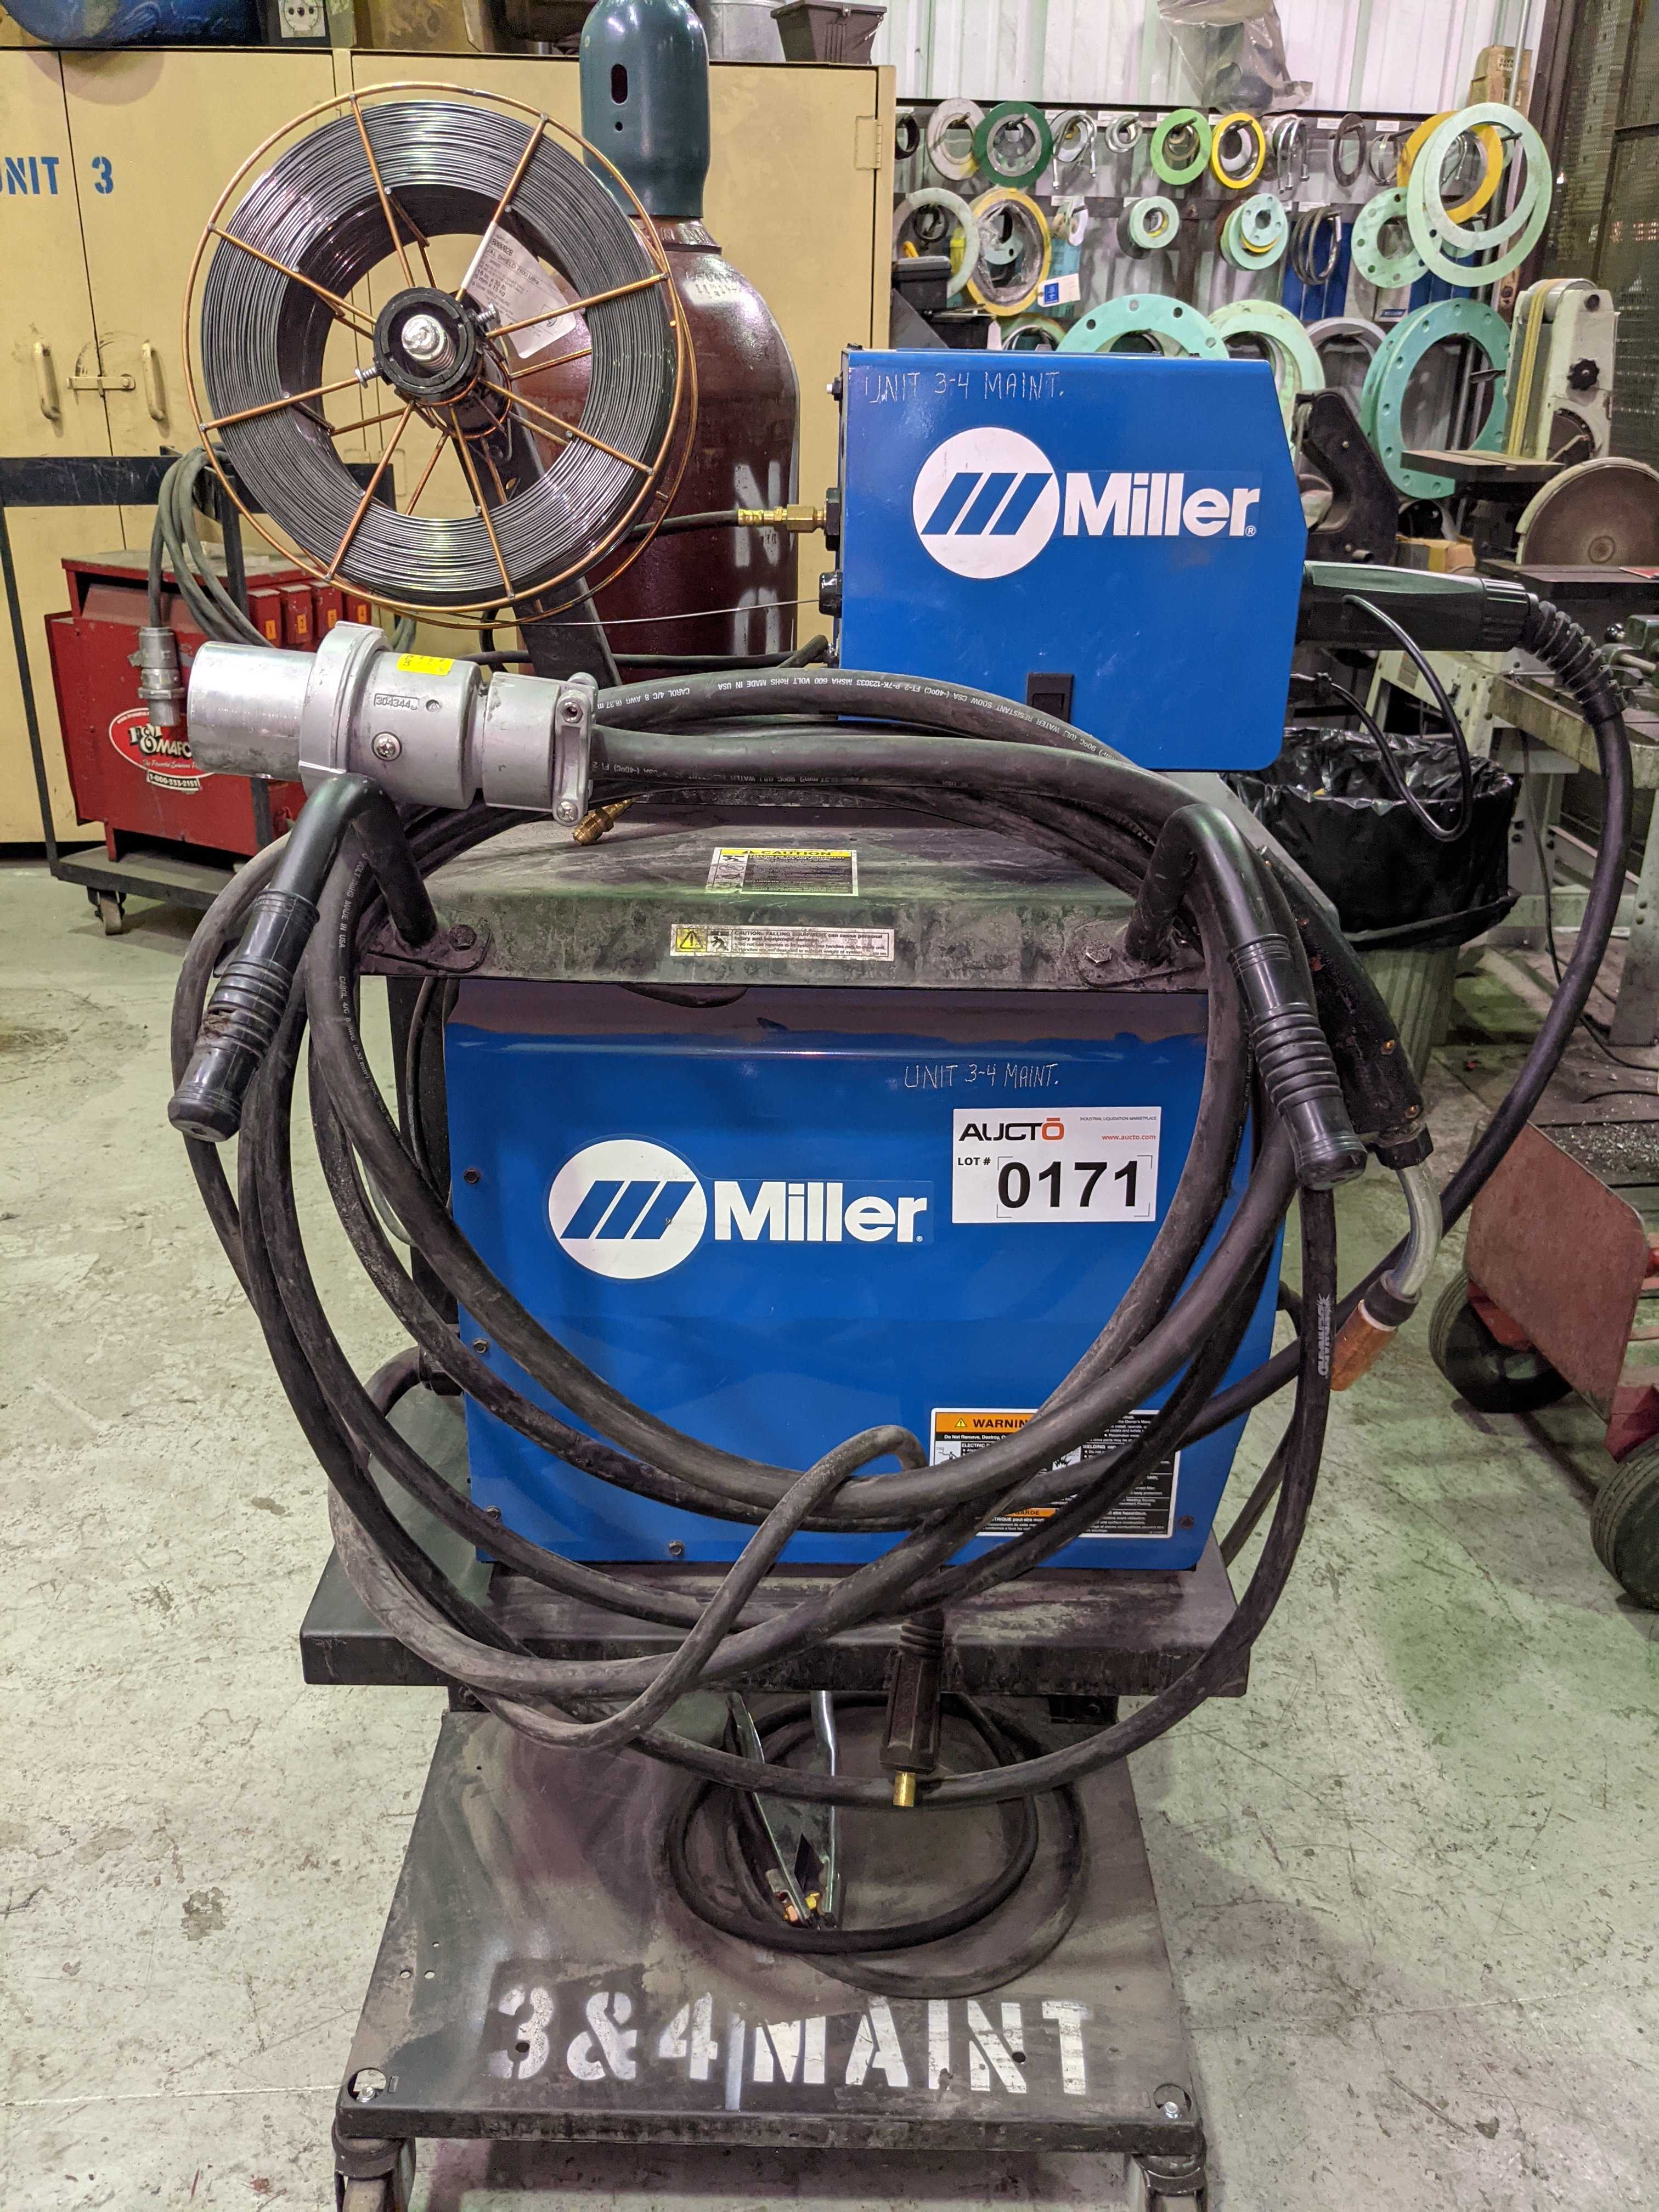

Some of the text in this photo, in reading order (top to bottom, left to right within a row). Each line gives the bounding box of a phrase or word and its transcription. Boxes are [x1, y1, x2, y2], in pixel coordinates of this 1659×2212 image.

[0, 156, 114, 194] NIT 3
[497, 254, 516, 269] SHIELD
[866, 371, 1065, 403] UNIT 3-4 MAINT.
[1063, 472, 1261, 537] Miller
[718, 682, 732, 691] USA
[747, 679, 766, 688] MADE
[625, 696, 641, 704] AWG
[668, 687, 690, 698] CAROL
[953, 692, 968, 702] CSA
[996, 705, 1034, 723] RESISTANT
[1036, 718, 1060, 734] WATER
[341, 900, 352, 921] MADE
[340, 923, 348, 932] IN
[338, 934, 347, 949] USA
[905, 1064, 958, 1089] UNIT
[1005, 1063, 1059, 1089] MAINT.
[957, 1156, 991, 1166] LOT #
[998, 1160, 1138, 1208] 0171
[714, 1181, 928, 1243] Miller
[973, 1419, 1028, 1429] WARNIN
[754, 1994, 1091, 2096] MAINT
